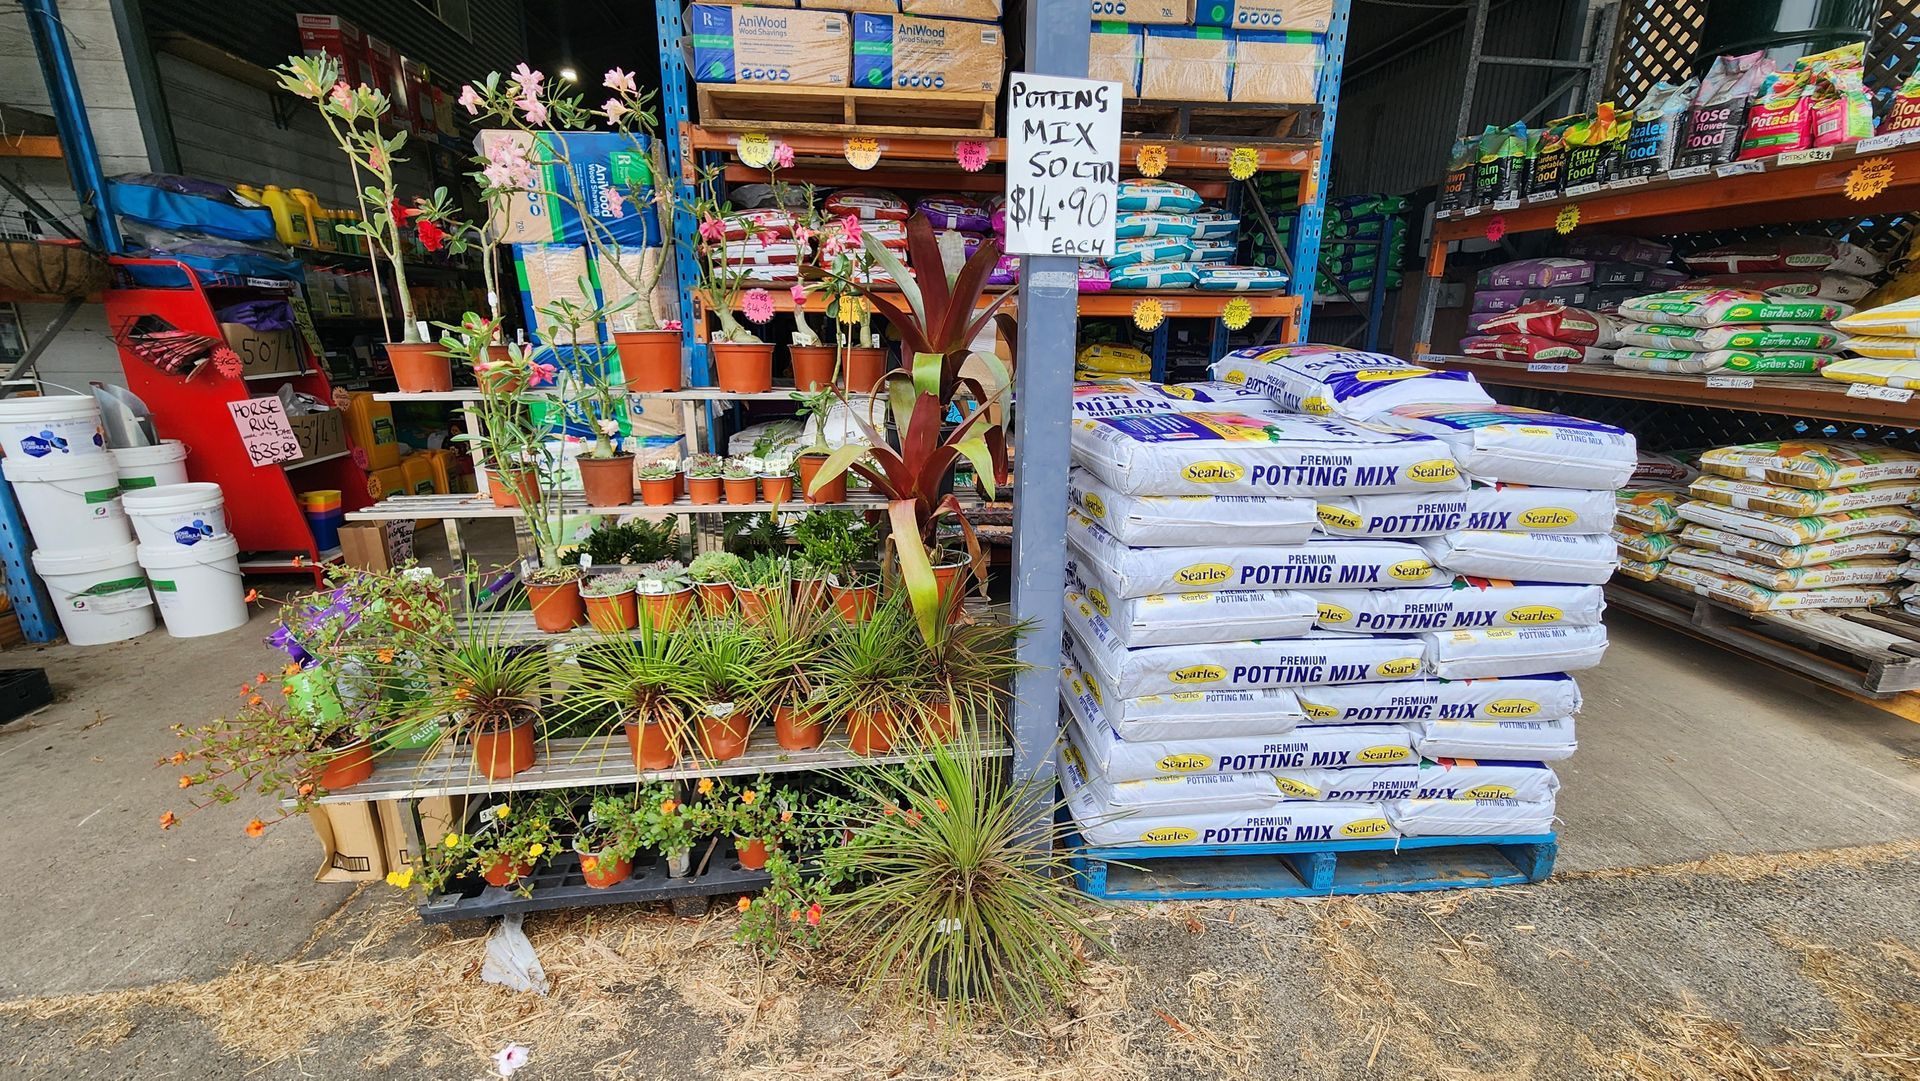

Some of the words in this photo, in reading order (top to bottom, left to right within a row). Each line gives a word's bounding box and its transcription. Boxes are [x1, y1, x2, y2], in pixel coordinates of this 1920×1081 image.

[703, 13, 713, 26] R
[739, 15, 786, 29] AniWood
[758, 28, 787, 37] Shavings
[865, 21, 873, 33] R
[898, 24, 945, 38] AniWood
[916, 37, 944, 46] Shavings
[1012, 82, 1109, 113] POTTING
[1692, 108, 1731, 123] Rose
[1751, 110, 1800, 128] Potash
[1696, 122, 1727, 131] Flower
[1023, 119, 1098, 154] MIX
[1686, 130, 1725, 148] Food
[617, 155, 631, 165] R
[588, 164, 596, 184] Wood
[1073, 161, 1117, 184] LTR
[1568, 163, 1595, 180] Food
[595, 164, 613, 217] AniWood
[1853, 181, 1884, 193] $10.90
[591, 185, 600, 216] Shavings
[1010, 184, 1107, 232] $14.90
[1052, 237, 1104, 255] EACH
[1494, 277, 1510, 286] LIME
[1555, 272, 1573, 281] LIME
[1610, 274, 1626, 282] LIME
[1489, 301, 1504, 309] LIME
[1760, 309, 1793, 318] Garden
[1795, 308, 1815, 318] Soil
[1794, 337, 1811, 346] Soil
[1535, 350, 1558, 359] BLOOD
[1788, 359, 1805, 369] Soil
[1246, 377, 1281, 400] POTTING
[1284, 391, 1301, 410] MIX
[234, 400, 280, 418] HORSE
[249, 415, 278, 432] RUG
[1557, 428, 1594, 438] PREMIUM
[1556, 433, 1589, 445] POTTING
[1589, 436, 1604, 446] MIX
[250, 442, 297, 464] $35.00
[1300, 455, 1352, 466] PREMIUM
[1188, 466, 1235, 479] Searles
[1251, 464, 1348, 487] POTTING
[1354, 466, 1399, 486] MIX
[1412, 463, 1456, 479] Searles
[1252, 496, 1267, 504] MIX
[1894, 492, 1907, 500] Mix
[1417, 502, 1467, 514] PREMIUM
[1368, 513, 1462, 533] POTTING
[1468, 512, 1512, 530] MIX
[1522, 511, 1569, 524] Searles
[1531, 533, 1561, 543] POTTING
[1563, 536, 1578, 544] MIX
[1876, 542, 1890, 550] Mix
[1288, 554, 1337, 565] PREMIUM
[1179, 568, 1226, 582] Searles
[1240, 565, 1331, 585] POTTING
[1339, 565, 1381, 583] MIX
[1874, 572, 1887, 580] Mix
[1181, 593, 1209, 601] Searles
[1216, 594, 1248, 603] POTTING
[1250, 594, 1266, 602] MIX
[1800, 597, 1828, 605] Organic
[1830, 596, 1853, 605] Potting
[1855, 596, 1868, 604] Mix
[1404, 603, 1453, 613] PREMIUM
[1356, 611, 1447, 630] POTTING
[1453, 611, 1498, 628] MIX
[1510, 610, 1555, 622] Searles
[1487, 629, 1512, 638] Searles
[1519, 632, 1550, 640] POTTING
[1280, 656, 1327, 666] PREMIUM
[1175, 669, 1221, 681] Searles
[1233, 665, 1327, 684] POTTING
[1328, 664, 1370, 681] MIX
[1173, 692, 1200, 700] Searles
[1206, 694, 1237, 703] POTTING
[1239, 693, 1254, 702] MIX
[1391, 696, 1438, 706] PREMIUM
[1343, 705, 1432, 720] POTTING
[1439, 704, 1479, 719] MIX
[1490, 703, 1533, 714] Searles
[1528, 722, 1542, 730] MIX
[1264, 743, 1309, 753] PREMIUM
[1363, 749, 1405, 760] Searles
[1162, 758, 1205, 769] Searles
[1219, 753, 1303, 771] POTTING
[1311, 751, 1350, 766] MIX
[1187, 775, 1217, 785] POTTING
[1219, 775, 1234, 784] MIX
[1373, 781, 1418, 790] PREMIUM
[1476, 799, 1504, 807] POTTING
[1507, 799, 1520, 807] MIX
[1247, 817, 1292, 827] PREMIUM
[1203, 826, 1288, 844] POTTING
[1296, 825, 1333, 841] MIX
[1346, 823, 1387, 835] Searles
[1147, 831, 1190, 842] Searles
